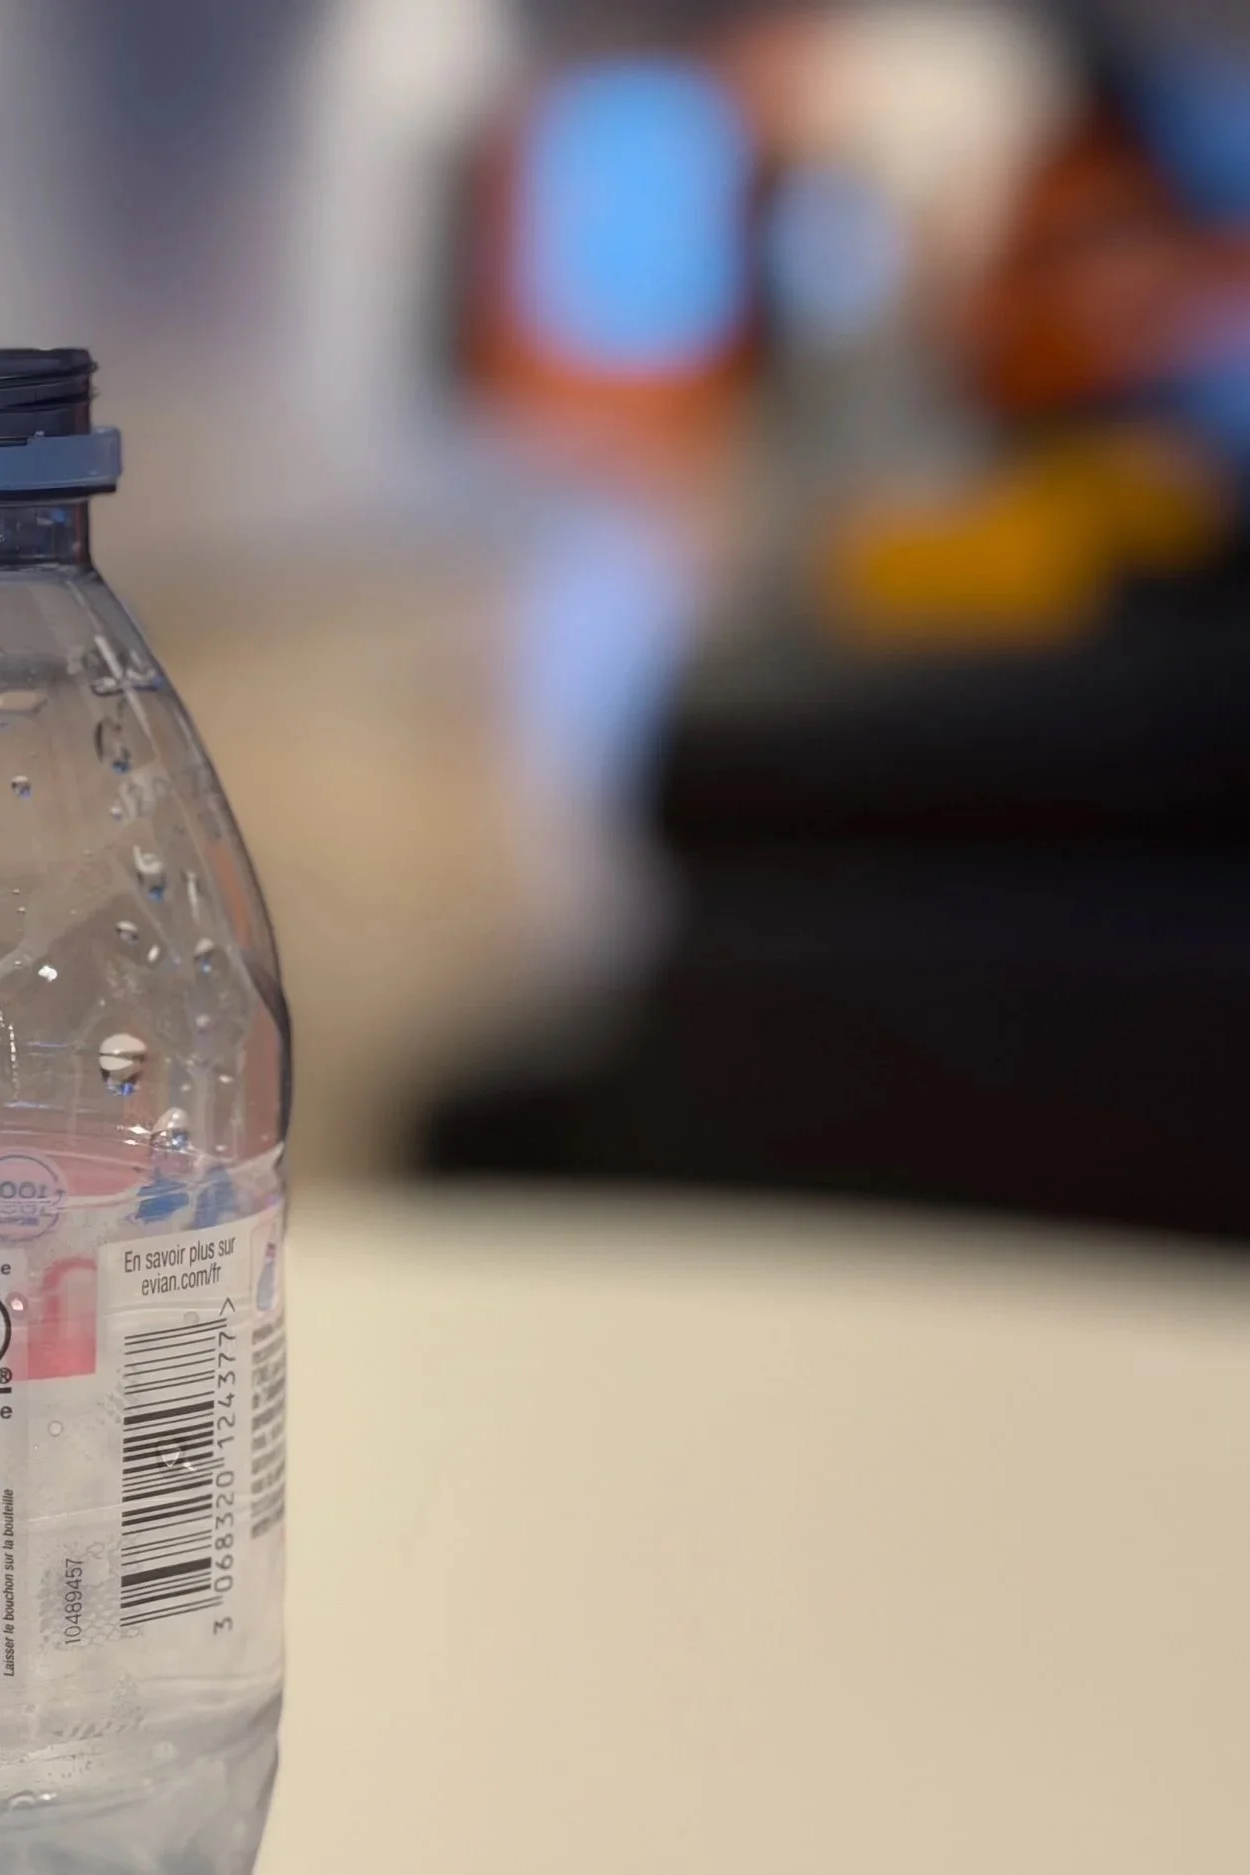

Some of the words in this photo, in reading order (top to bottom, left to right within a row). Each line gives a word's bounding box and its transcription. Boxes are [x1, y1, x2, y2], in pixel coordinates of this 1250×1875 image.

[124, 1251, 141, 1273] En
[145, 1247, 185, 1270] savoir
[189, 1241, 215, 1266] plus
[218, 1237, 236, 1257] sur
[141, 1263, 222, 1296] evian.com/fr
[217, 1331, 237, 1449] 124377
[1, 1488, 15, 1536] bouteille
[2, 1539, 15, 1549] la
[214, 1470, 236, 1594] 068320
[4, 1552, 15, 1570] sur
[2, 1573, 14, 1620] bouchon
[64, 1558, 84, 1645] 10489457
[3, 1624, 15, 1635] le
[213, 1616, 234, 1636] 3
[3, 1637, 15, 1677] Laisser
